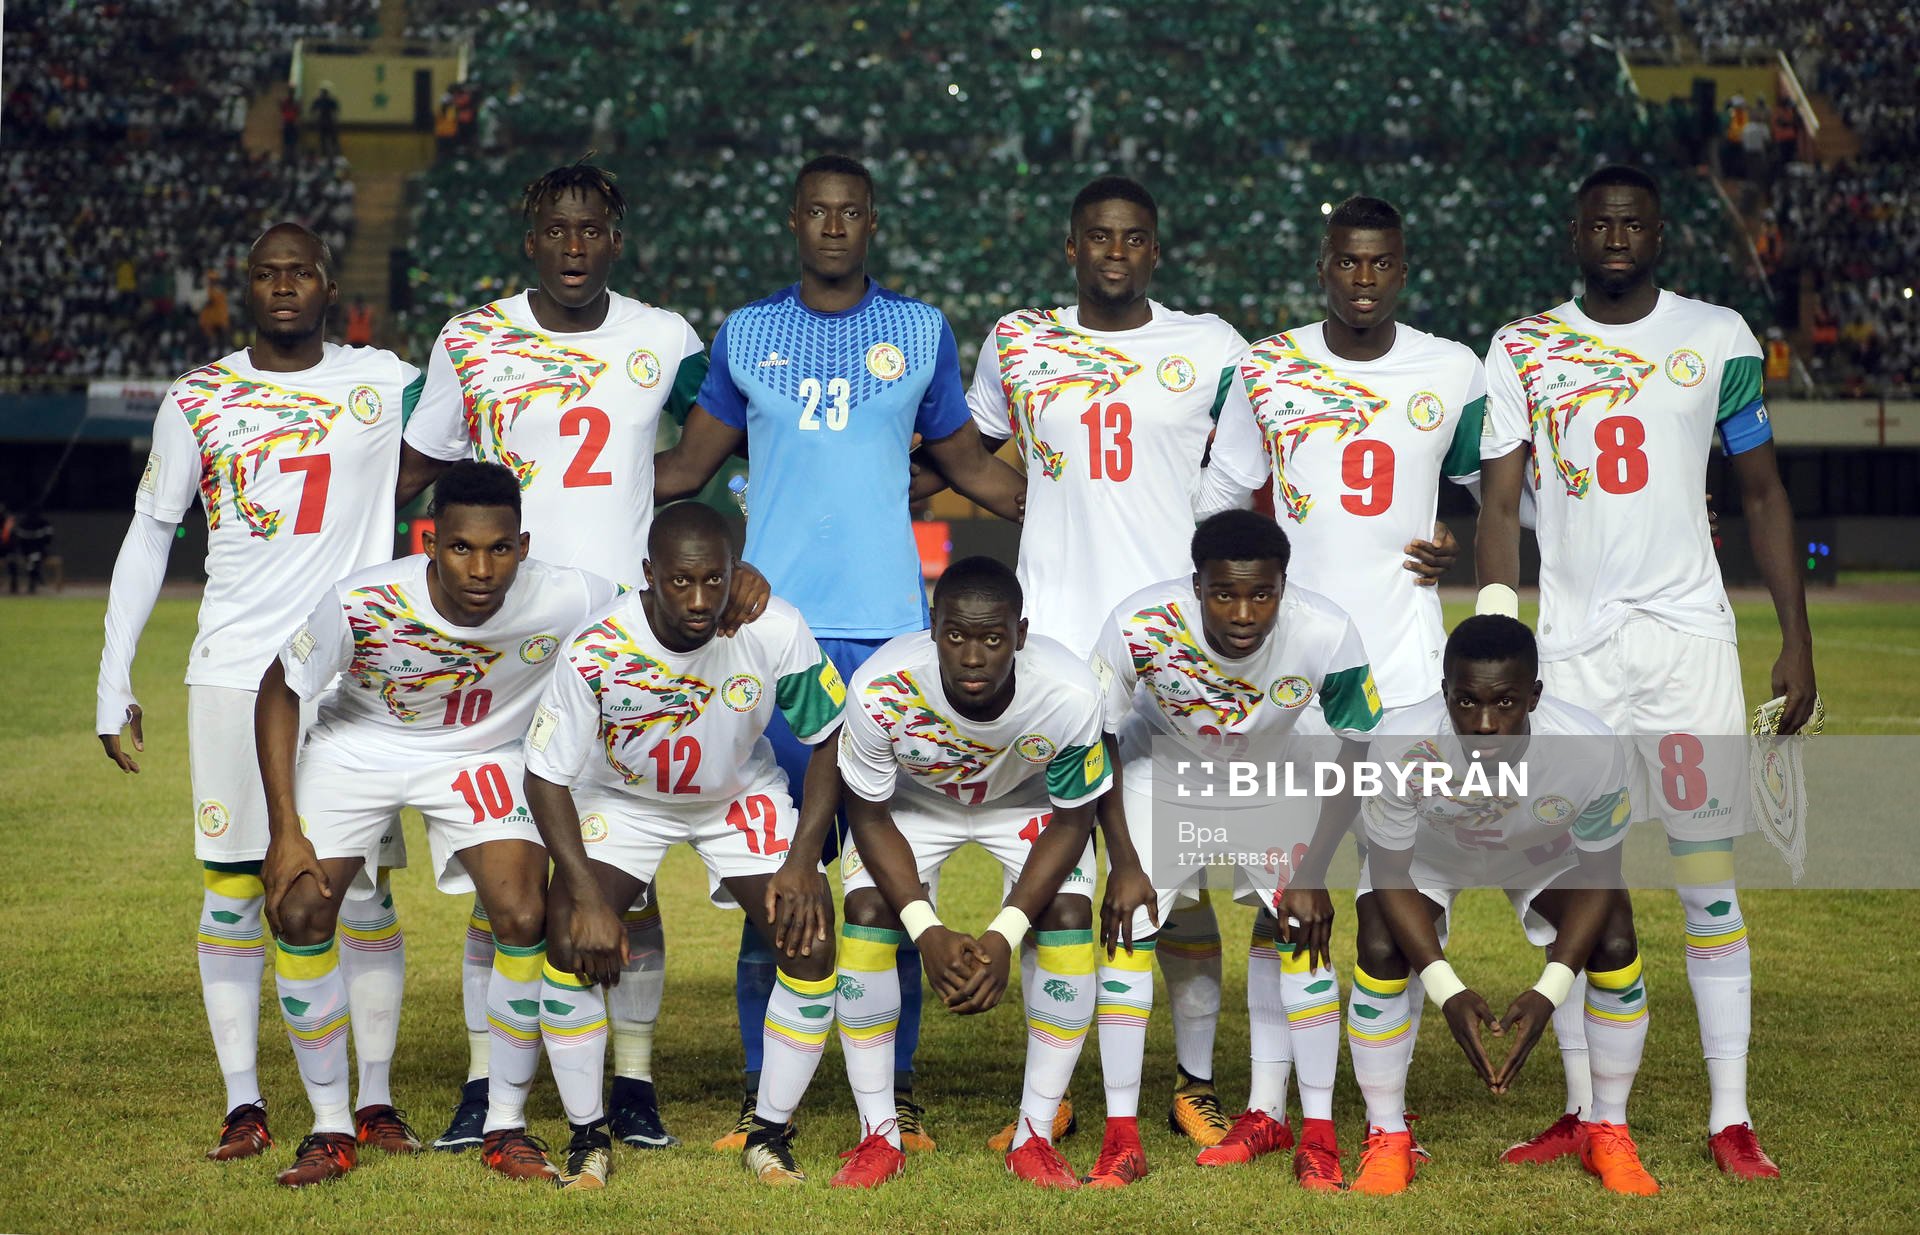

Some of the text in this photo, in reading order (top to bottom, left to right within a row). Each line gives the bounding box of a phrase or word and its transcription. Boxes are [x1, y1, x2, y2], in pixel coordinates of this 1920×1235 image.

[799, 378, 849, 431] 23
[1081, 402, 1133, 482] 13
[559, 406, 612, 488] 2
[1340, 439, 1395, 517] 9
[1595, 415, 1649, 494] 8
[279, 453, 331, 535] 7
[440, 688, 492, 727] 10
[452, 763, 514, 824] 10
[648, 735, 702, 795] 12
[1658, 733, 1707, 811] 8
[725, 794, 789, 856] 12
